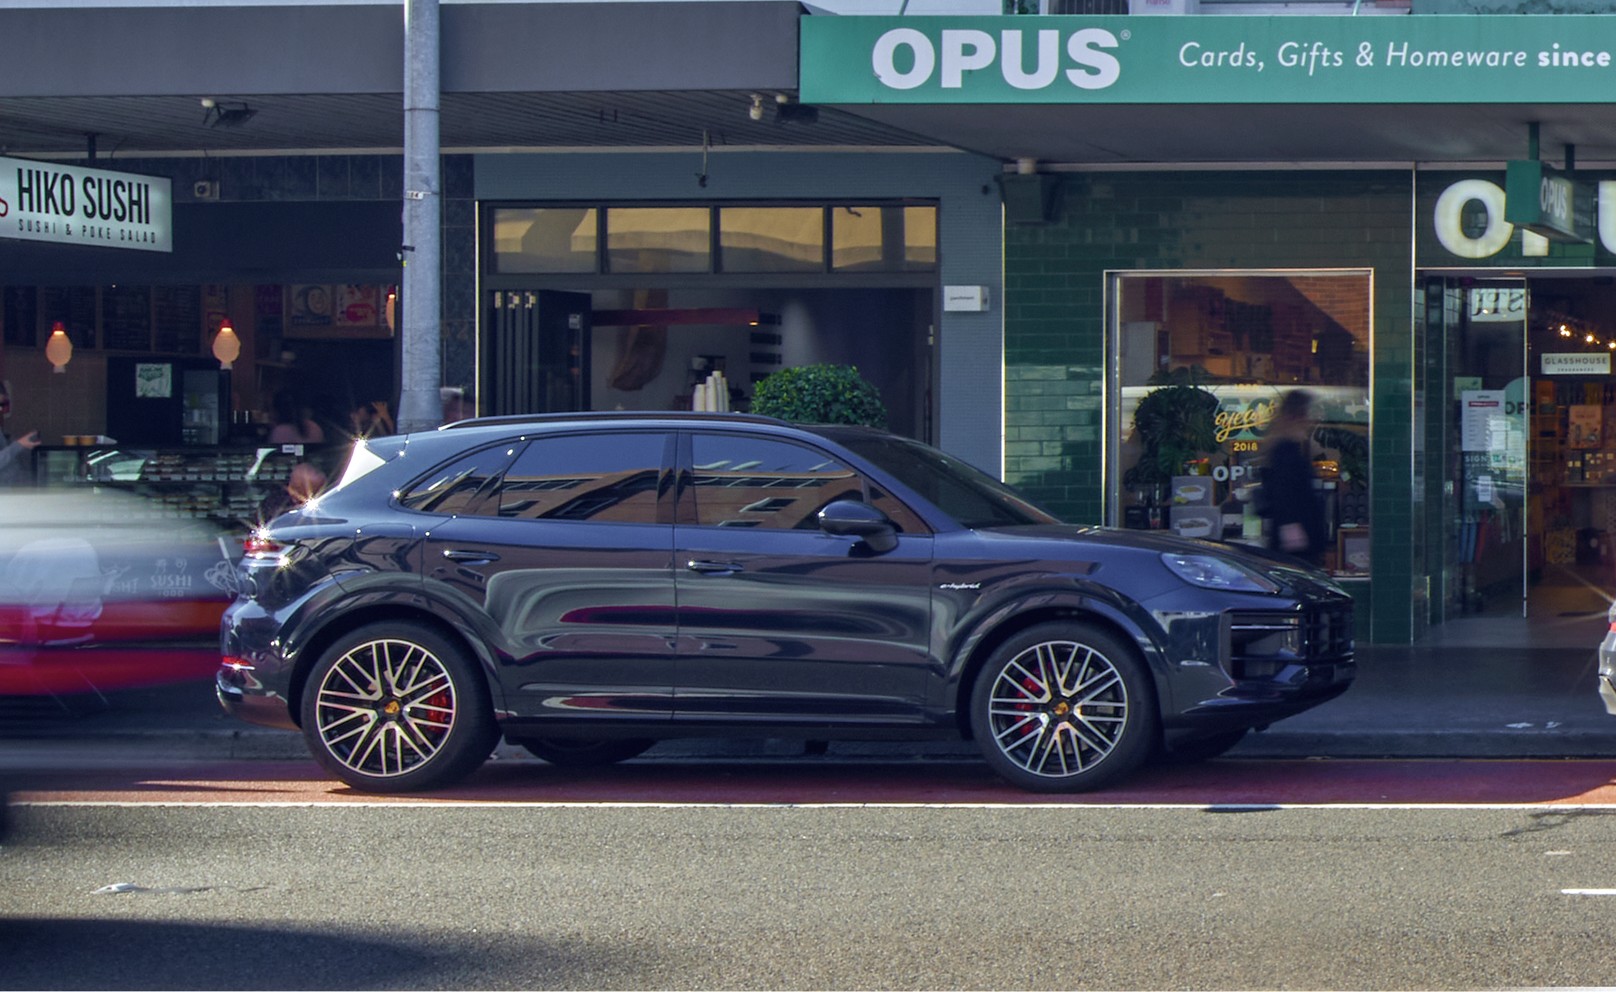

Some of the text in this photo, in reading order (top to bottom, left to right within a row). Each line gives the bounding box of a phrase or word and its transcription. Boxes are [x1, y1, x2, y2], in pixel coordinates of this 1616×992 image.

[1178, 41, 1266, 72] Cards,
[1277, 42, 1344, 76] Gifts
[1355, 42, 1375, 68] &
[1386, 42, 1528, 68] Homeware
[1537, 42, 1612, 68] since
[17, 167, 151, 225] HIKO SUSHI
[1540, 176, 1568, 220] OPUS
[18, 218, 57, 234] SUSHI
[82, 224, 112, 240] POKE
[1544, 357, 1608, 365] GLASSHOUSE
[1233, 442, 1258, 451] 2018
[149, 574, 192, 587] SUSHI
